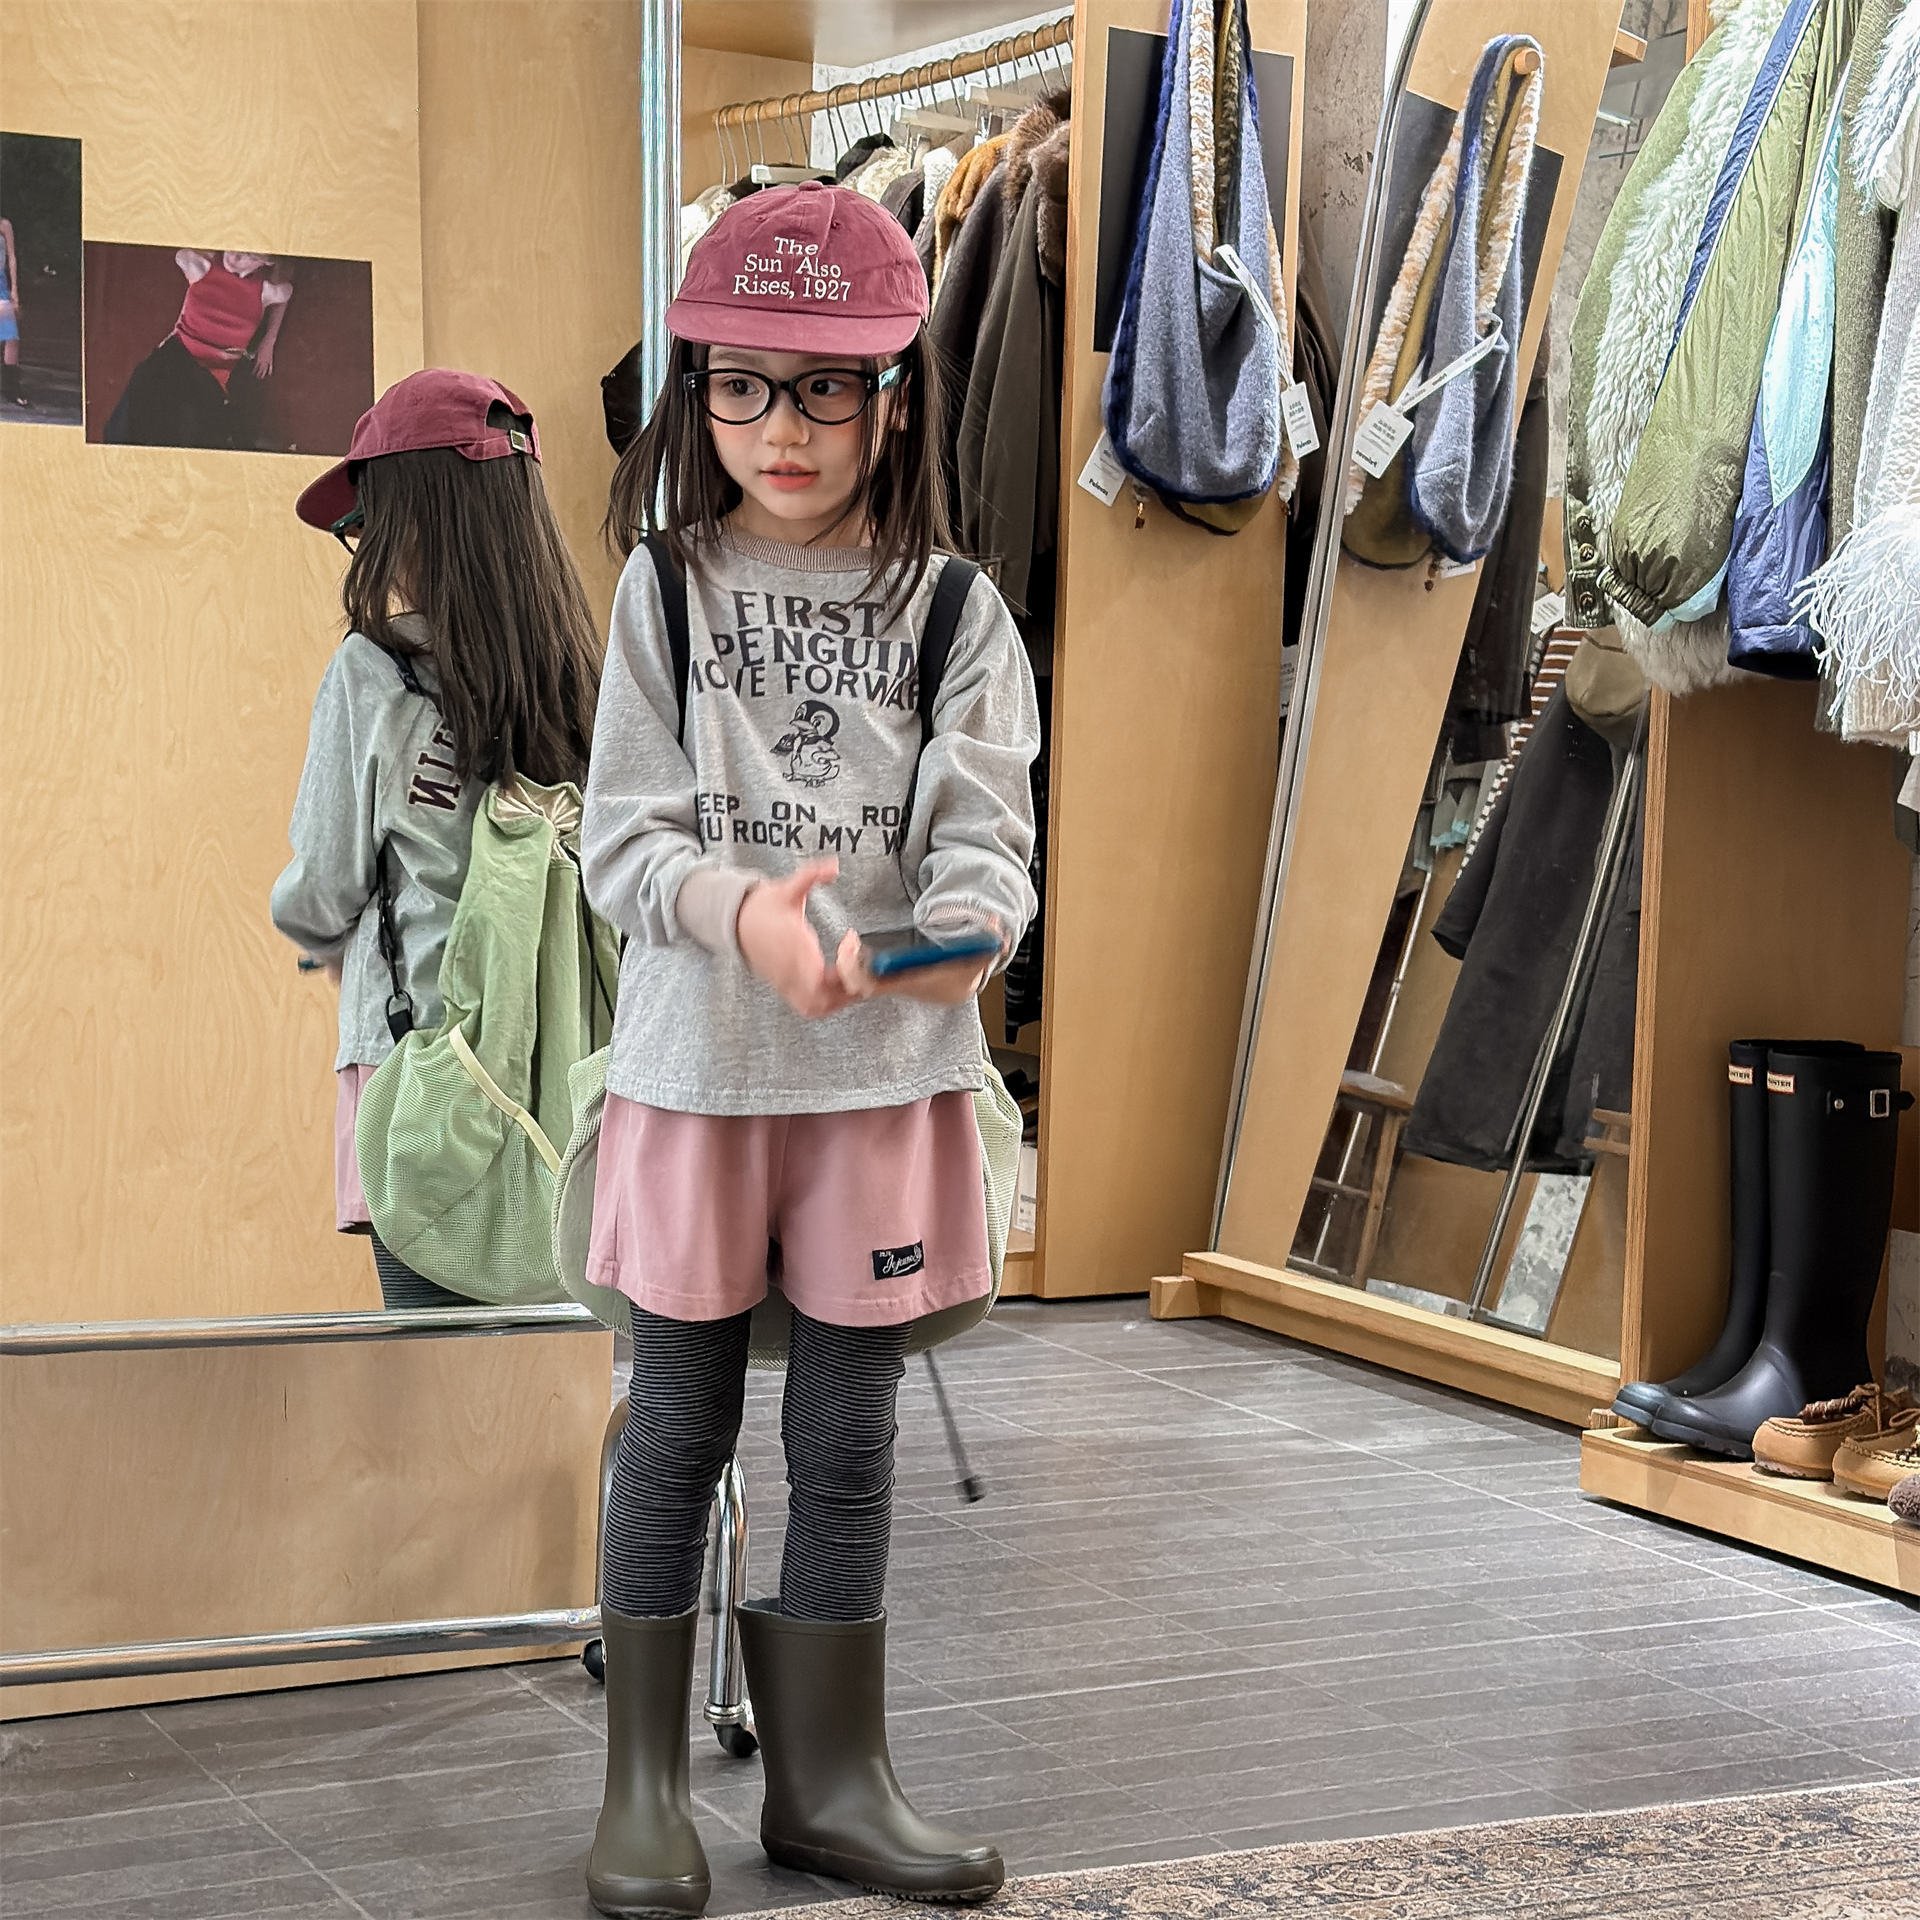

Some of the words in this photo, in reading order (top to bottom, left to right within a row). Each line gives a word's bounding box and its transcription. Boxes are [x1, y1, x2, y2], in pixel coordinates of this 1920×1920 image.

[774, 236, 818, 256] The
[744, 253, 783, 273] Sun
[796, 256, 842, 278] Also
[732, 274, 795, 299] Rises,
[802, 277, 851, 302] 1927
[730, 590, 886, 638] FIRST
[697, 792, 741, 815] EEP
[771, 800, 816, 823] ON
[862, 805, 903, 827] RO
[733, 819, 804, 850] ROCK
[819, 825, 864, 854] MY
